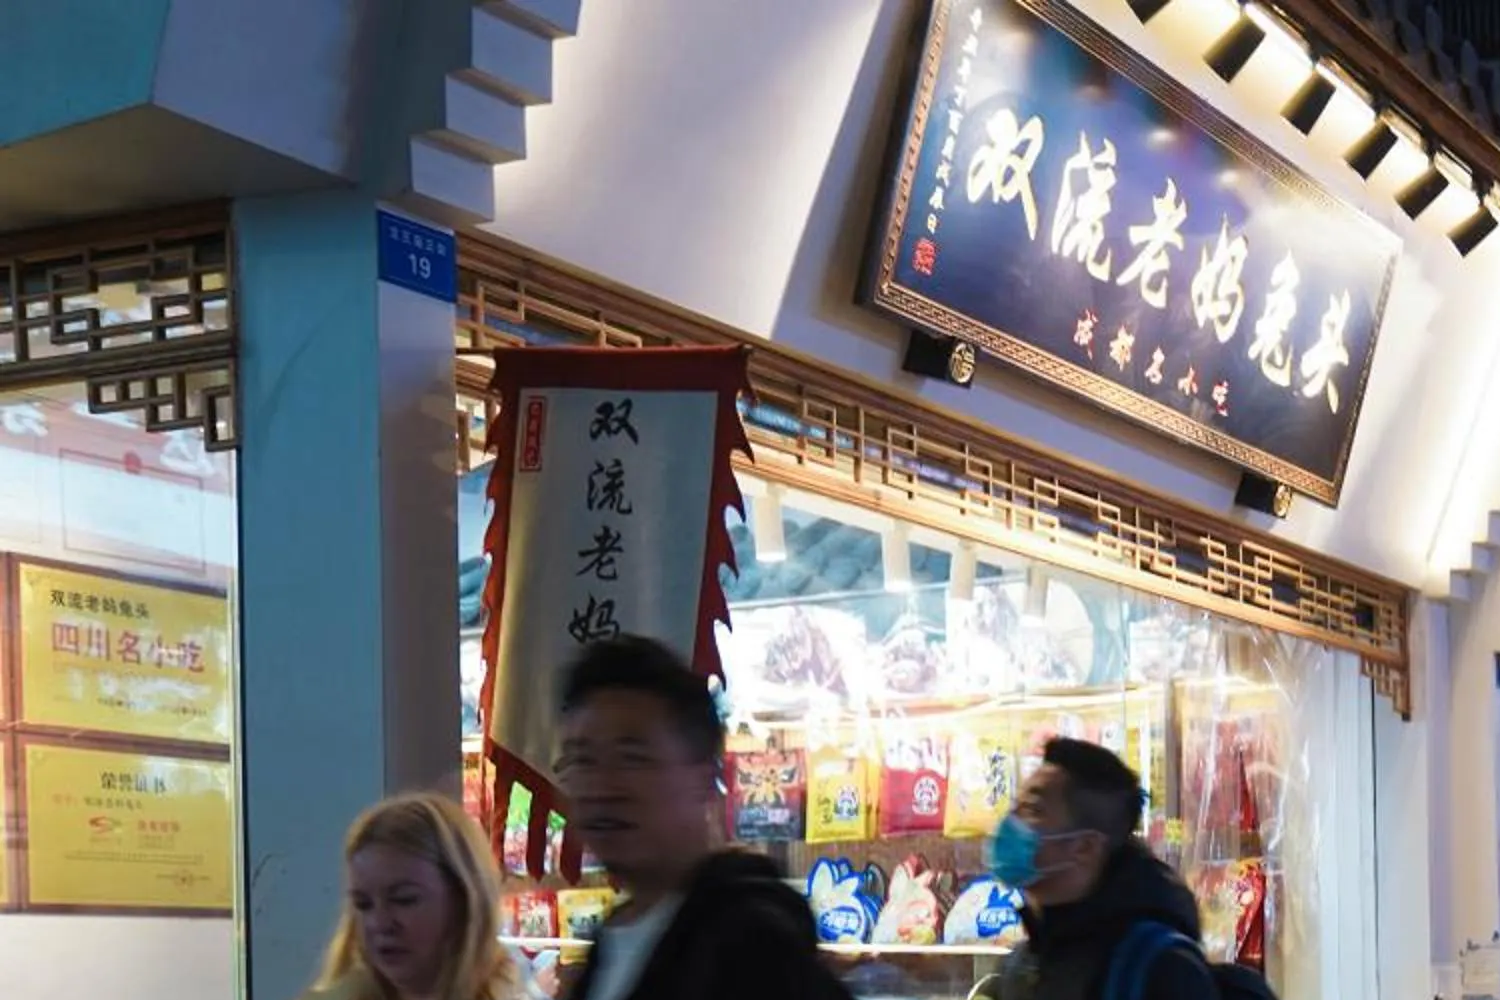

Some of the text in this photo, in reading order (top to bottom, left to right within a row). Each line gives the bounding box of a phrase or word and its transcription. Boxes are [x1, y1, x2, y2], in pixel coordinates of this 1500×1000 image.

[408, 253, 431, 279] 19
[966, 109, 1352, 414] 双流老妈兔头
[567, 397, 639, 643] 双流老妈
[50, 589, 150, 619] 双流老妈兔头
[52, 621, 206, 673] 四川名小吃
